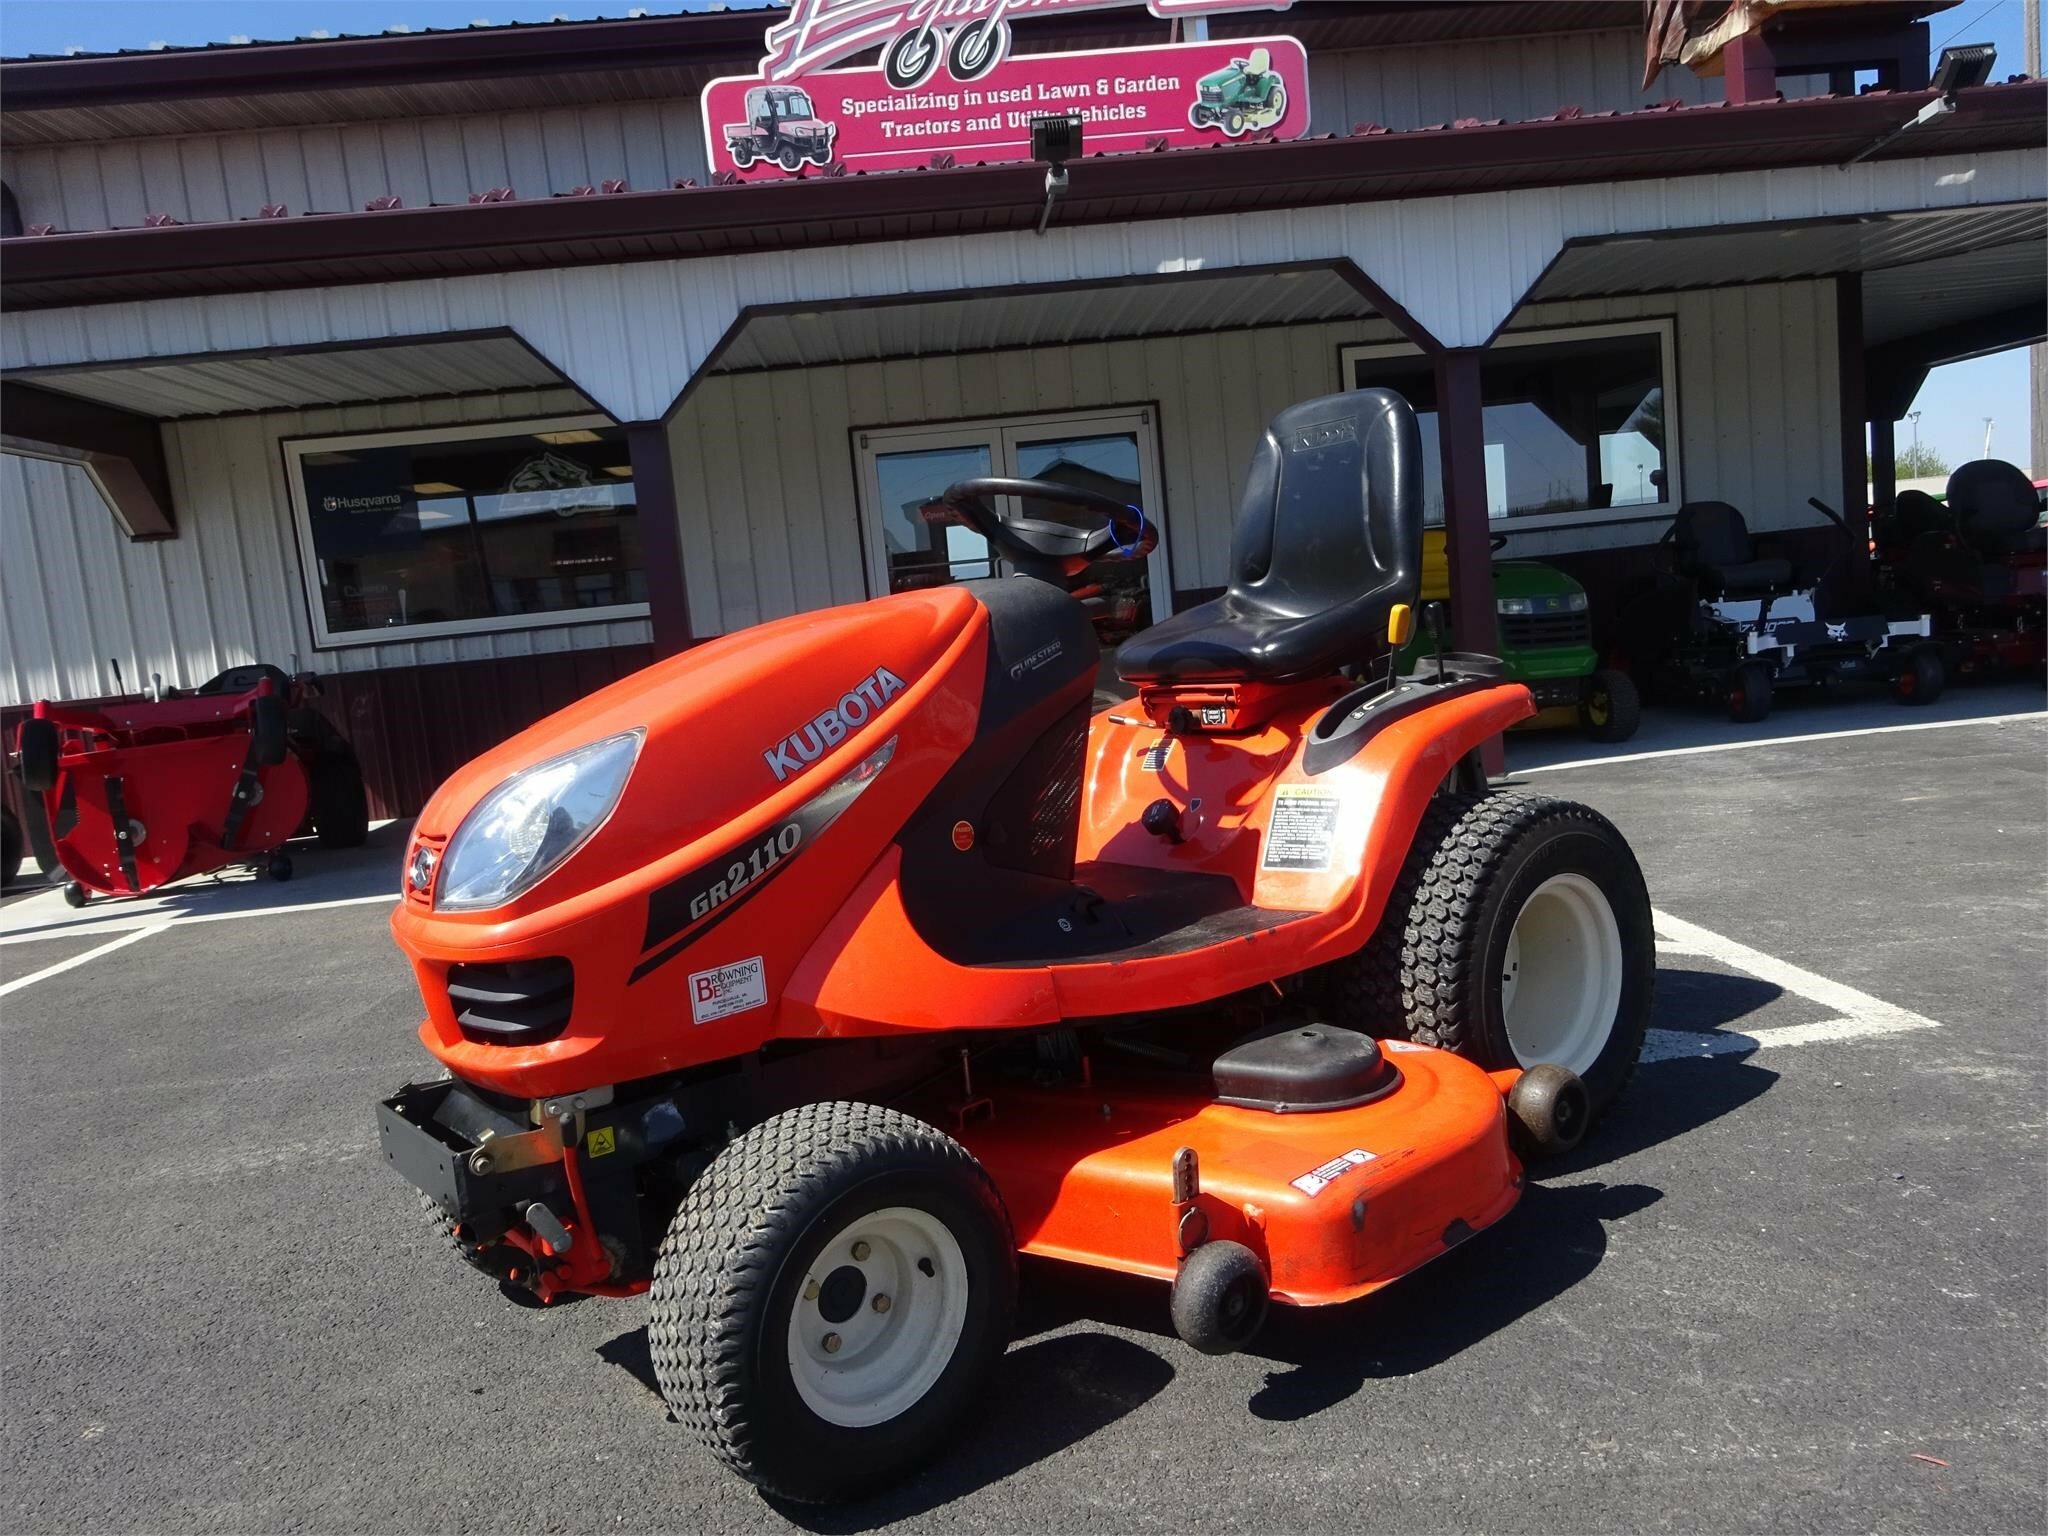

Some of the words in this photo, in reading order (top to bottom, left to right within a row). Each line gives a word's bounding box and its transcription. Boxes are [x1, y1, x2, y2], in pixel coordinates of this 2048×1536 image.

[842, 91, 959, 117] Specializing
[963, 89, 983, 106] in
[986, 84, 1032, 103] used
[1037, 83, 1091, 100] Lawn
[1096, 78, 1109, 96] &
[1114, 74, 1180, 95] Garden
[881, 119, 961, 138] Tractors
[966, 112, 1002, 132] and
[1006, 109, 1062, 128] Util
[337, 494, 401, 509] Husqvarna
[762, 665, 907, 782] KUBOTA
[690, 823, 802, 921] GR2110
[696, 963, 758, 1003] BROWNING
